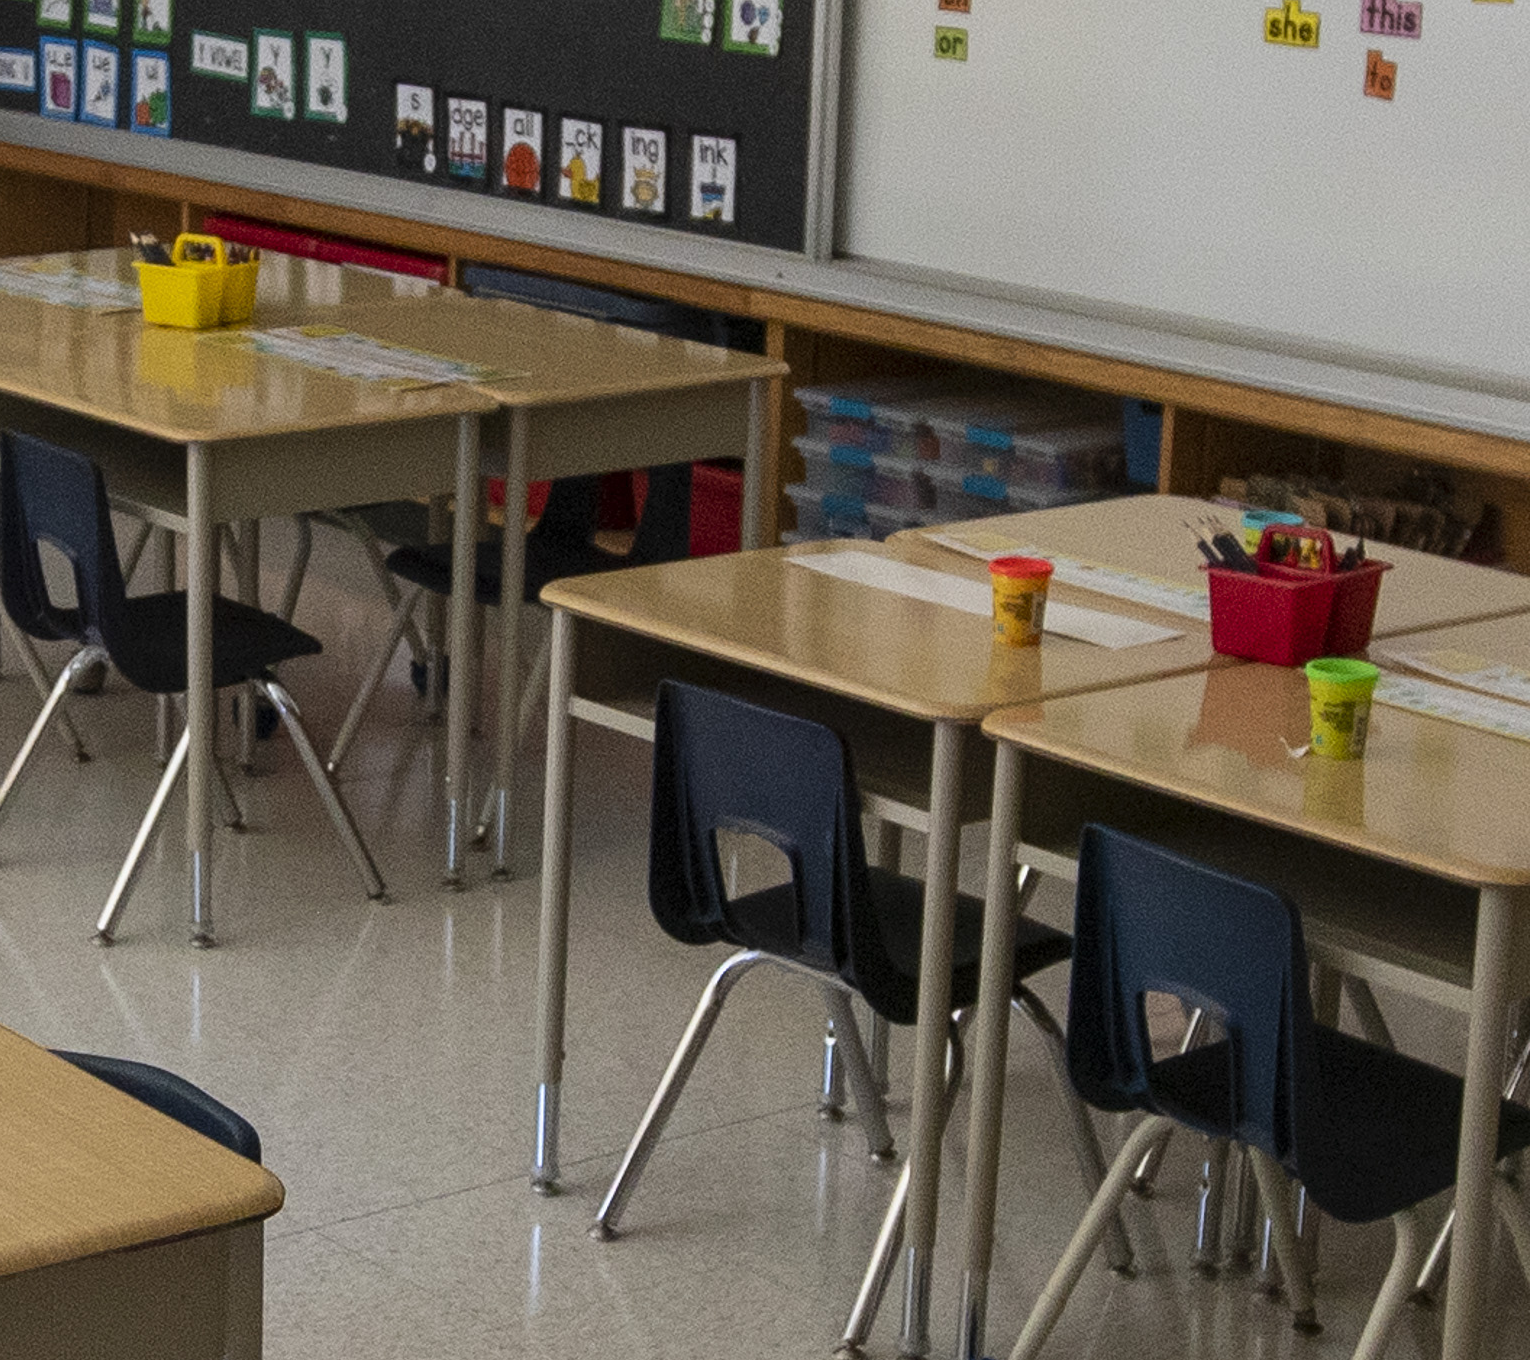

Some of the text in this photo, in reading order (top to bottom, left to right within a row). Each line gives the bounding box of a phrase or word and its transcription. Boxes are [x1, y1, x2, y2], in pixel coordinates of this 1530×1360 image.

[1268, 2, 1314, 42] she
[938, 34, 964, 57] or
[1368, 59, 1391, 93] to
[630, 130, 660, 165] ing
[698, 136, 730, 167] ink
